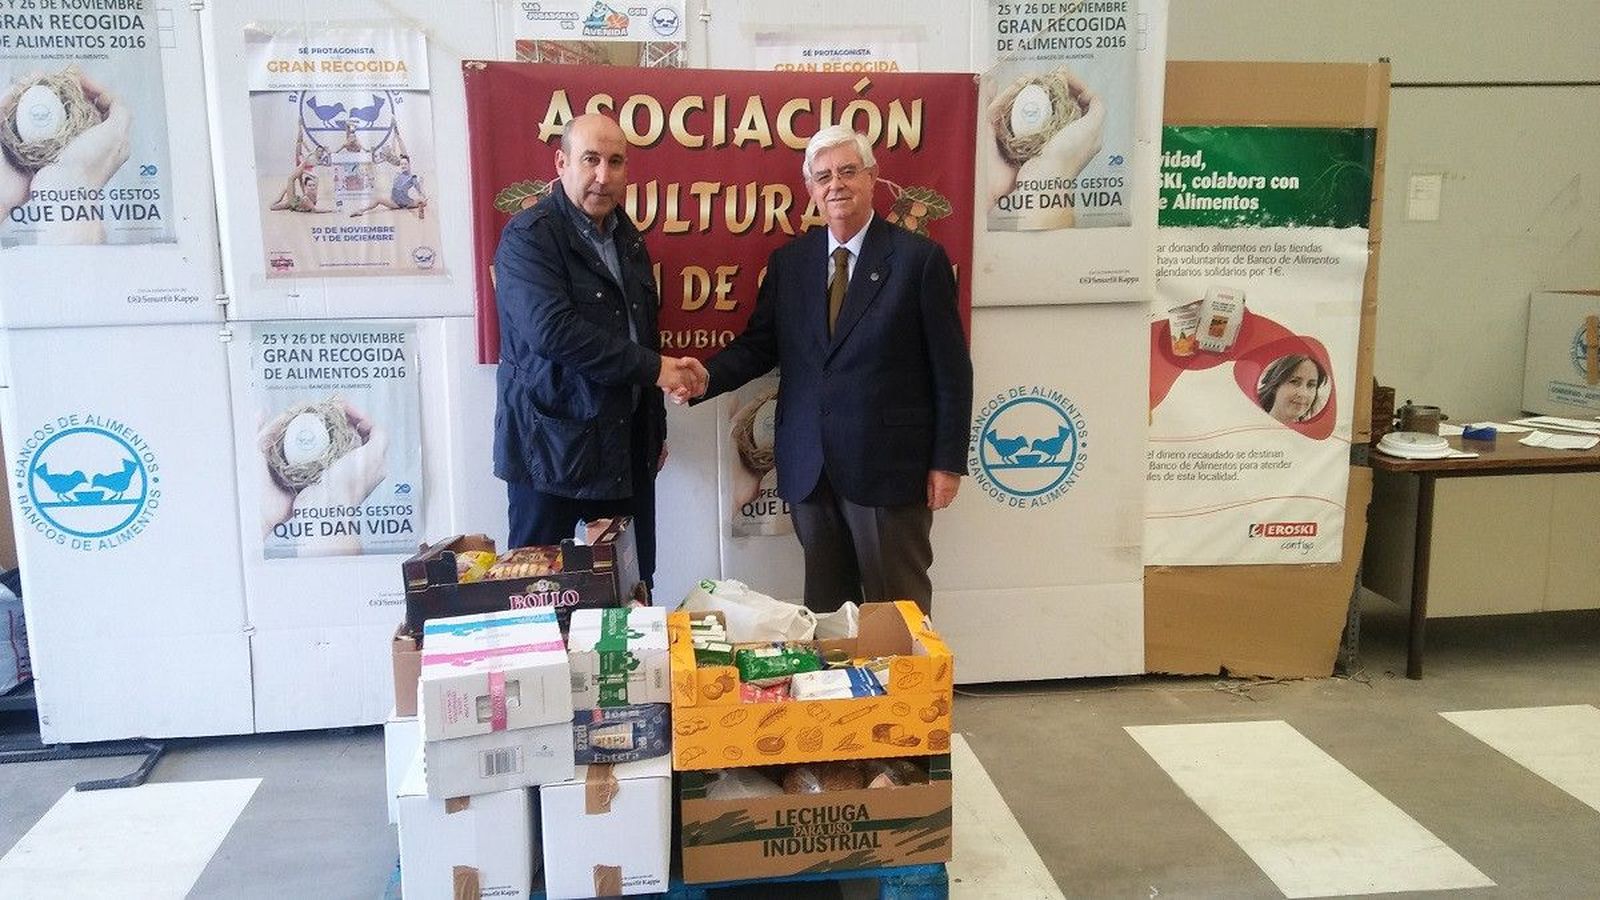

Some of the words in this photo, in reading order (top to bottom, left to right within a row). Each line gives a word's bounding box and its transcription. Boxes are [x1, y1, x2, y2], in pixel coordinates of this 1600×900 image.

[9, 0, 15, 9] Y
[20, 0, 36, 9] 26
[41, 0, 57, 9] DE
[61, 0, 144, 10] NOVIEMBRE
[997, 4, 1011, 15] 25
[1014, 4, 1021, 14] Y
[1025, 3, 1039, 14] 26
[1041, 3, 1056, 14] DE
[1059, 1, 1127, 13] NOVIEMBRE
[50, 14, 145, 30] RECOGIDA
[997, 18, 1042, 34] GRAN
[1048, 17, 1127, 32] RECOGIDA
[582, 27, 628, 37] AVENIDA
[16, 35, 105, 48] ALIMENTOS
[110, 35, 146, 49] 2016
[997, 39, 1013, 51] DE
[1016, 37, 1092, 51] ALIMENTOS
[1095, 36, 1127, 48] 2016
[311, 47, 375, 55] PROTAGONISTA
[814, 48, 871, 56] PROTAGONISTA
[266, 60, 316, 73] GRAN
[320, 60, 408, 73] RECOGIDA
[823, 60, 900, 73] RECOGIDA
[1016, 177, 1078, 191] PEQUEÑOS
[1080, 177, 1124, 189] GESTOS
[1191, 172, 1266, 189] colabora
[1270, 176, 1300, 189] con
[31, 188, 105, 202] PEQUEÑOS
[109, 188, 161, 201] GESTOS
[997, 195, 1034, 212] QUE
[1039, 192, 1075, 210] DAN
[1081, 191, 1123, 207] VIDA
[1173, 193, 1260, 210] Alimentos
[9, 205, 58, 224] QUE
[61, 204, 104, 222] DAN
[110, 204, 162, 221] VIDA
[625, 181, 829, 236] ULTURA
[311, 226, 323, 235] 30
[325, 226, 337, 234] DE
[340, 226, 395, 234] NOVIEMBRE
[343, 234, 394, 242] DICIEMBRE
[1168, 243, 1210, 253] donando
[1211, 243, 1258, 253] alimentos
[1259, 244, 1271, 252] en
[1274, 243, 1287, 252] las
[1288, 242, 1322, 252] tiendas
[1156, 255, 1179, 267] haya
[1181, 255, 1231, 265] voluntarios
[1233, 255, 1245, 265] de
[1247, 255, 1276, 265] Banco
[1278, 255, 1290, 265] de
[1293, 254, 1340, 265] Alimentos
[1204, 266, 1247, 277] solidarios
[1249, 269, 1265, 279] por
[680, 266, 738, 312] DE
[262, 334, 277, 345] 25
[281, 334, 288, 344] Y
[291, 333, 307, 344] 26
[310, 333, 326, 344] DE
[330, 332, 406, 344] NOVIEMBRE
[263, 349, 313, 363] GRAN
[319, 348, 406, 362] RECOGIDA
[264, 367, 281, 380] DE
[286, 366, 369, 380] ALIMENTOS
[372, 366, 406, 378] 2016
[969, 394, 1006, 442] BANCOS
[1009, 385, 1027, 398] DE
[1031, 386, 1088, 438] ALIMENTOS
[15, 423, 55, 478] BANCOS
[58, 414, 80, 428] DE
[84, 414, 159, 473] ALIMENTOS
[1156, 450, 1185, 459] dinero
[1187, 450, 1234, 459] recaudado
[1237, 451, 1246, 459] se
[1149, 461, 1177, 470] Banco
[1179, 461, 1191, 470] de
[1193, 461, 1238, 470] Alimentos
[1239, 461, 1258, 472] para
[1260, 460, 1292, 470] atender
[968, 457, 1006, 504] BANCOS
[1008, 497, 1026, 509] DE
[1031, 452, 1088, 508] ALIMENTOS
[1163, 472, 1175, 481] de
[1177, 472, 1196, 481] esta
[1198, 472, 1239, 481] localidad.
[293, 505, 363, 519] PEQUEÑOS
[365, 505, 413, 517] GESTOS
[741, 501, 777, 517] QUE
[17, 494, 67, 545] BANCOS
[71, 538, 92, 551] DE
[98, 488, 162, 551] ALIMENTOS
[273, 521, 314, 540] QUE
[320, 520, 361, 536] DAN
[366, 519, 413, 535] VIDA
[1267, 523, 1314, 535] EROSKI
[1280, 540, 1314, 555] contigo
[508, 589, 580, 611] BOLLO
[776, 804, 870, 827] LECHUGA
[792, 825, 825, 838] PARA
[826, 822, 853, 836] USO
[763, 831, 882, 857] INDUSTRIAL
